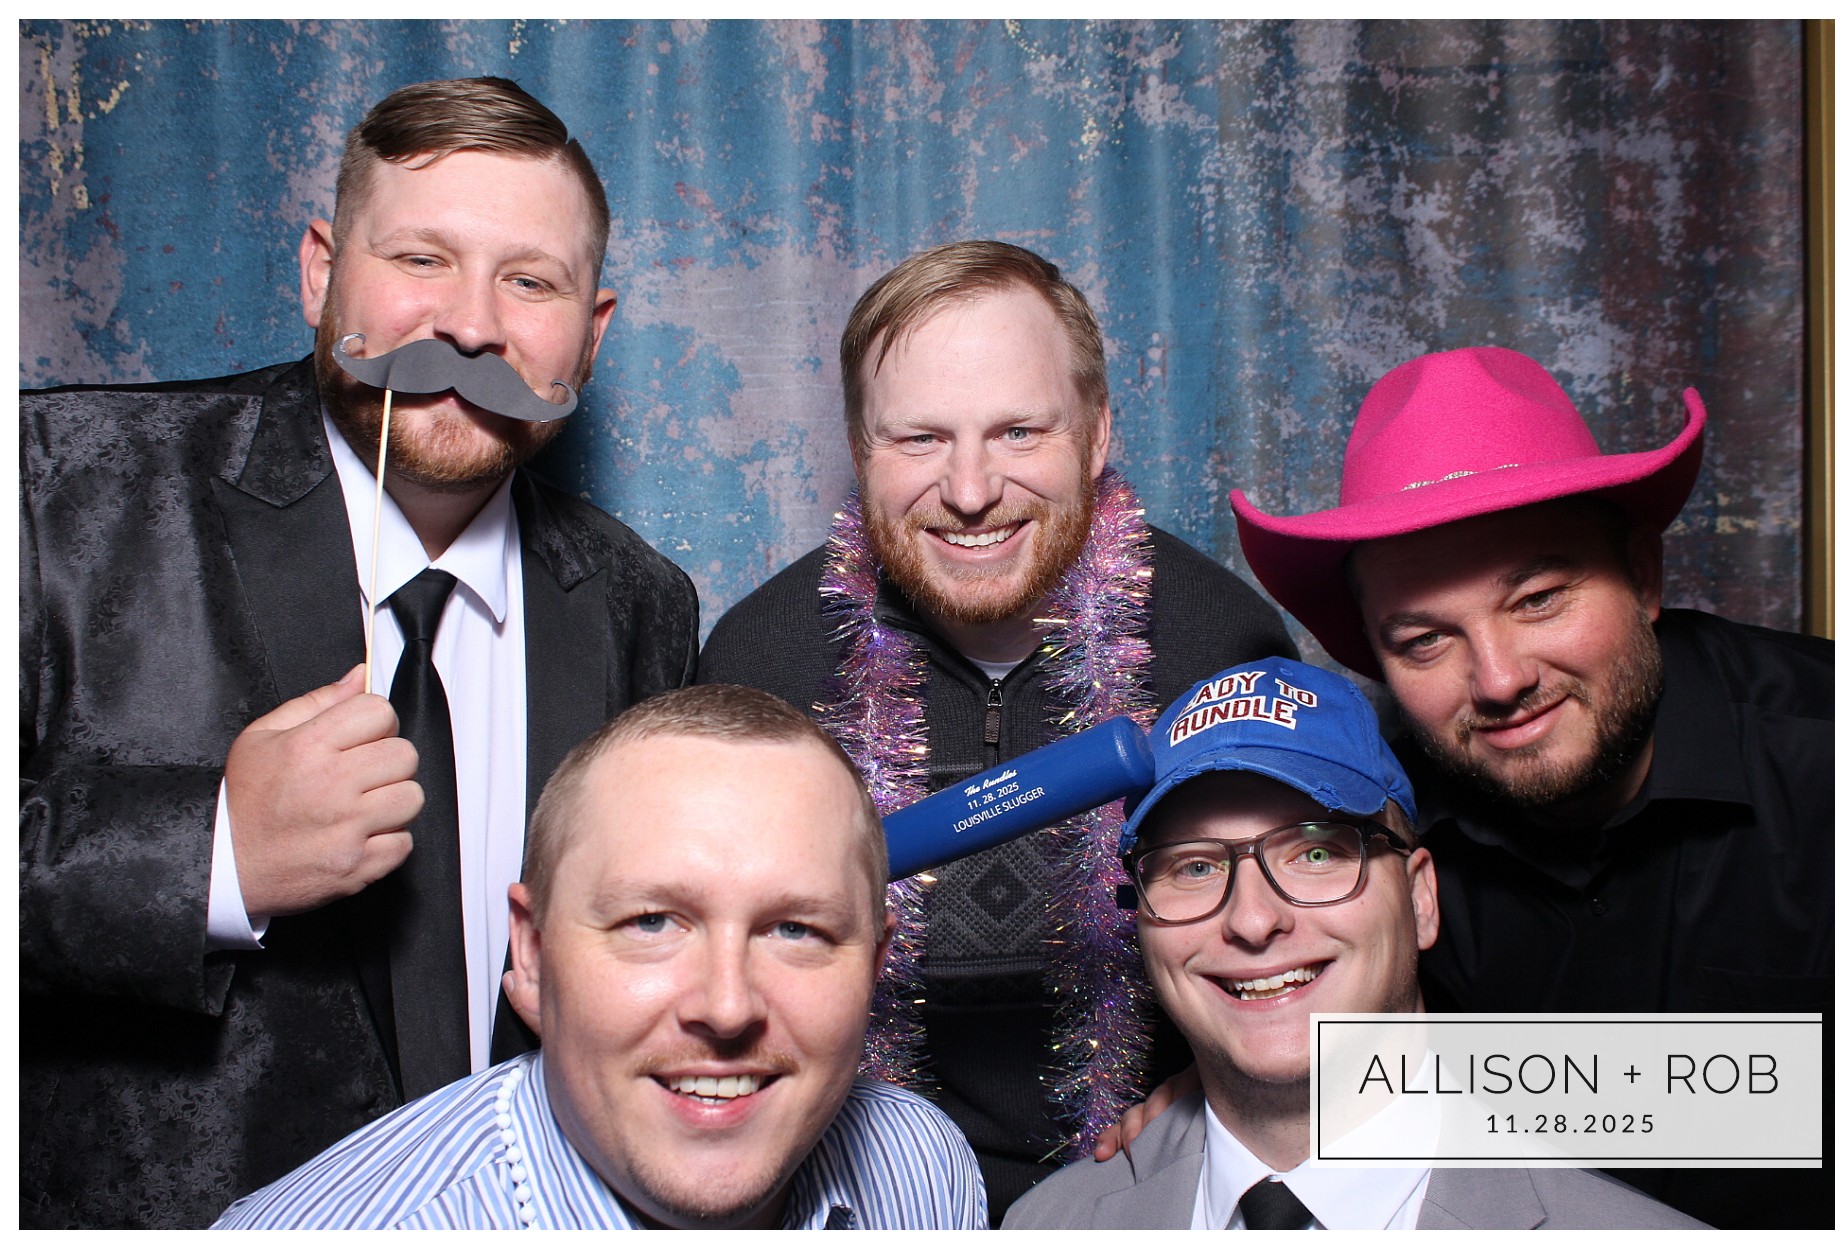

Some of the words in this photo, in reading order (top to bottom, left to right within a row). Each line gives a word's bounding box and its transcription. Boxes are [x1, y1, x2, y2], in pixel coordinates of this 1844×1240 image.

[1275, 678, 1317, 708] TO
[1170, 695, 1298, 748] RUNDLE
[964, 785, 981, 797] The
[982, 769, 1017, 790] Rundles
[967, 799, 982, 810] 11.
[982, 792, 997, 805] 28.
[996, 781, 1019, 798] 2025
[953, 804, 1003, 833] LOUISVILLE
[1001, 786, 1046, 812] SLUGGER
